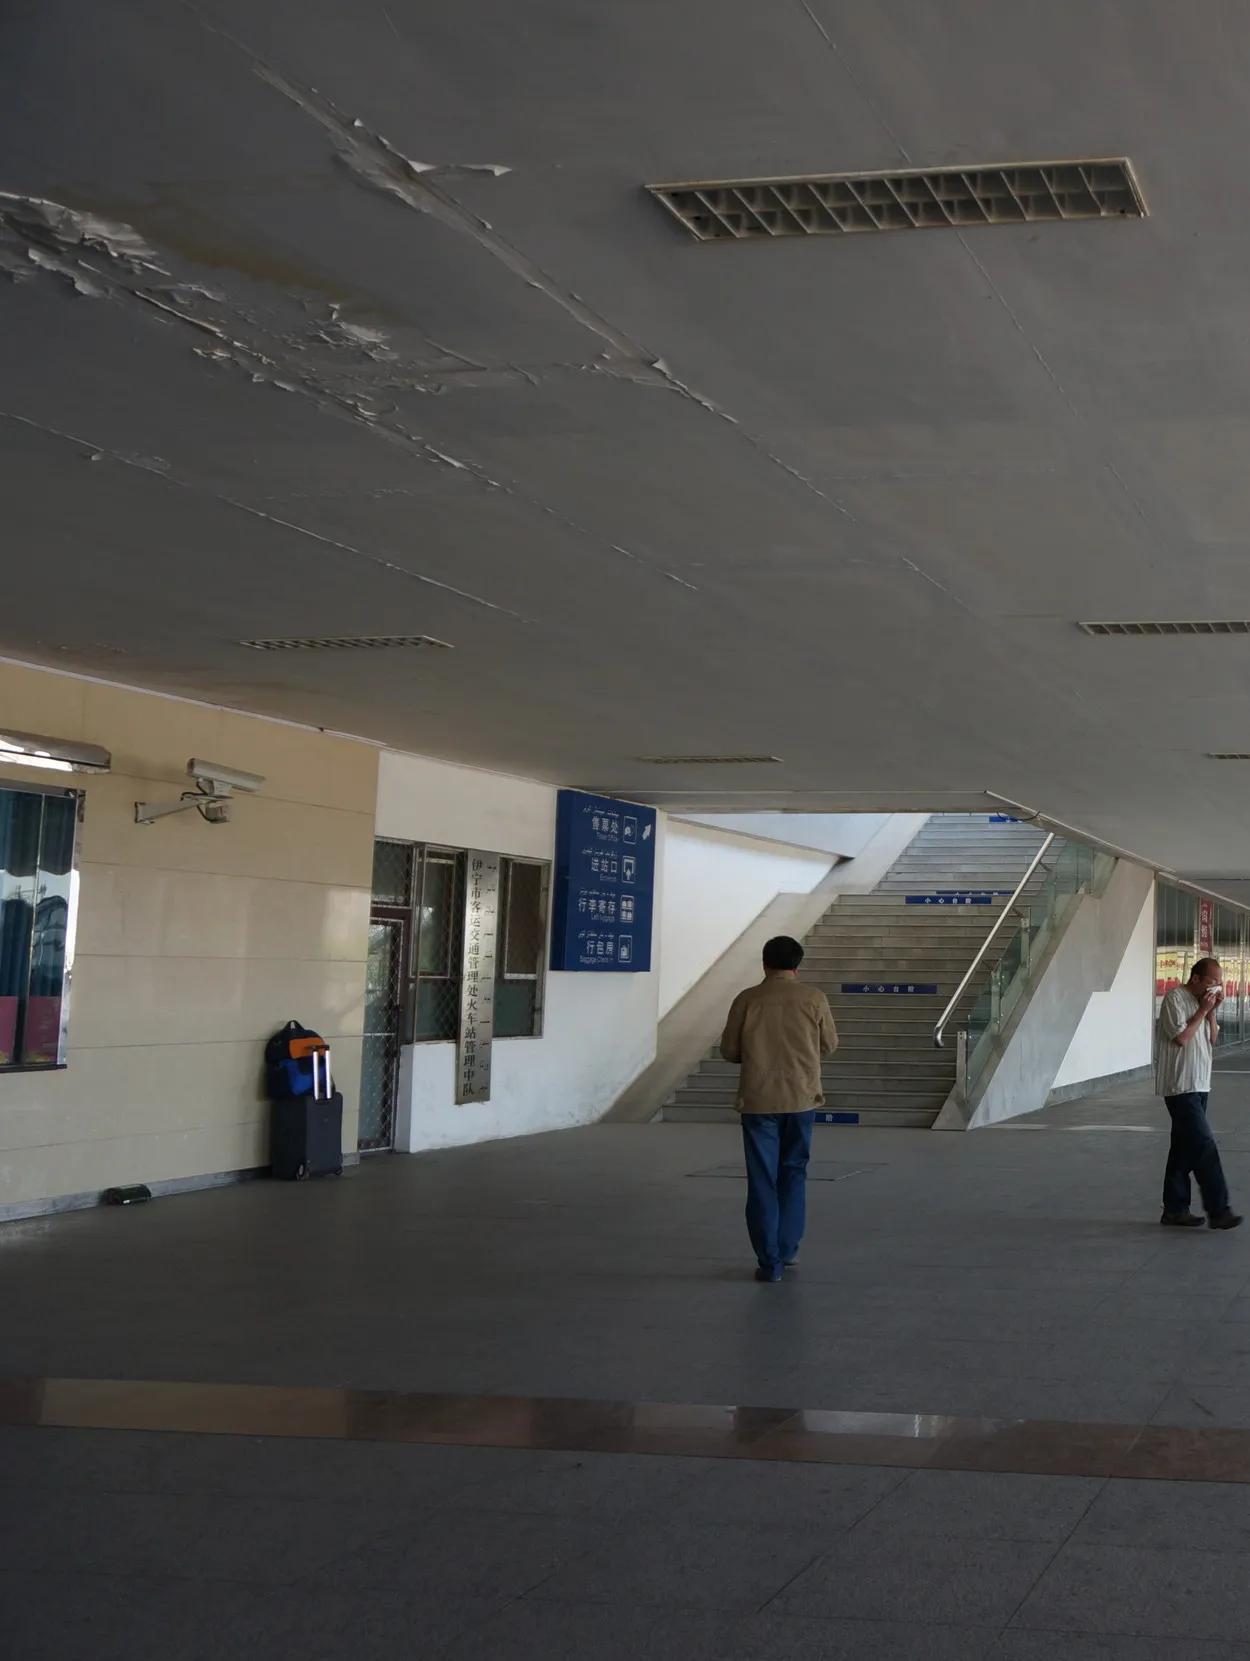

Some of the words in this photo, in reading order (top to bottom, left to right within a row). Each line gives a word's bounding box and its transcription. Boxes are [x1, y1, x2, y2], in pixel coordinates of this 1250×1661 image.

[591, 815, 619, 835] 售票处
[590, 857, 618, 874] 进站口
[577, 897, 616, 915] 行李寄存
[923, 896, 972, 905] 小心台阶
[586, 940, 614, 955] 行包房
[862, 984, 916, 993] 小心台阶
